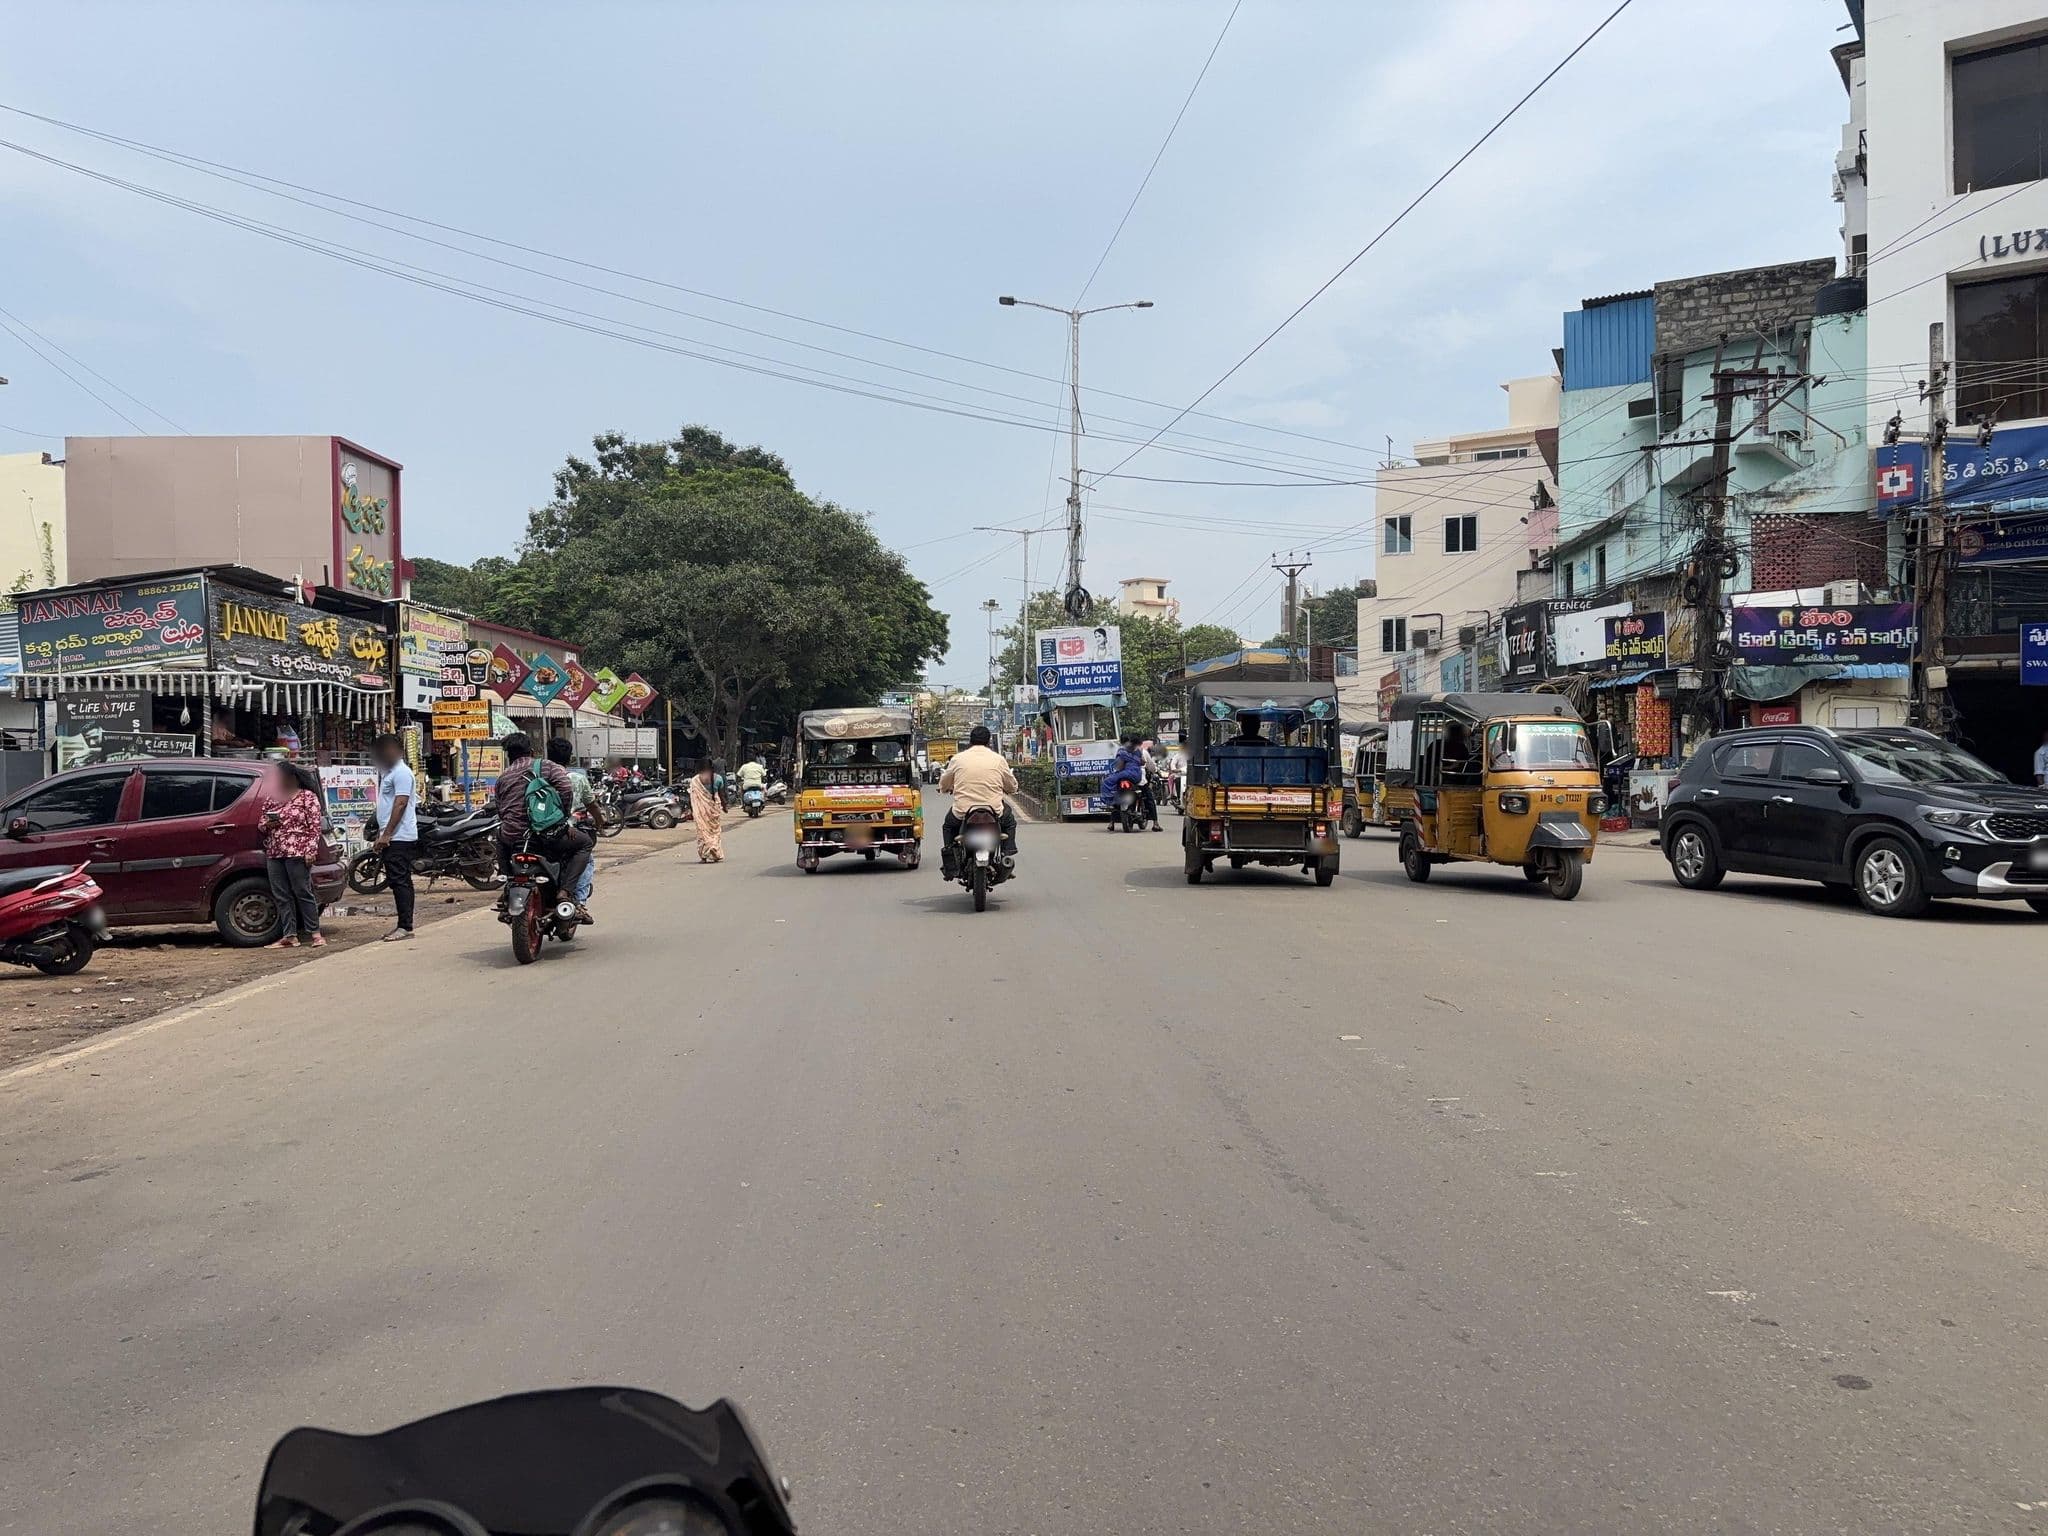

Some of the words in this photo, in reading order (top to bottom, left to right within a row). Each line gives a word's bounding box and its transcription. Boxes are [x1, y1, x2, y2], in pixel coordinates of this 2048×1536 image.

[137, 586, 167, 597] 88862
[170, 582, 199, 593] 22162
[22, 591, 123, 624] JANNAT
[1547, 601, 1592, 611] TEENEGE
[218, 601, 290, 641] JANNAT
[1825, 633, 1837, 646] &
[1622, 640, 1628, 655] &
[1058, 666, 1090, 676] TRAFFIC
[1091, 664, 1118, 674] POLICE
[1065, 677, 1091, 686] ELURU
[1093, 676, 1112, 684] CITY
[79, 701, 100, 713] LIFE
[153, 740, 168, 749] LIFE
